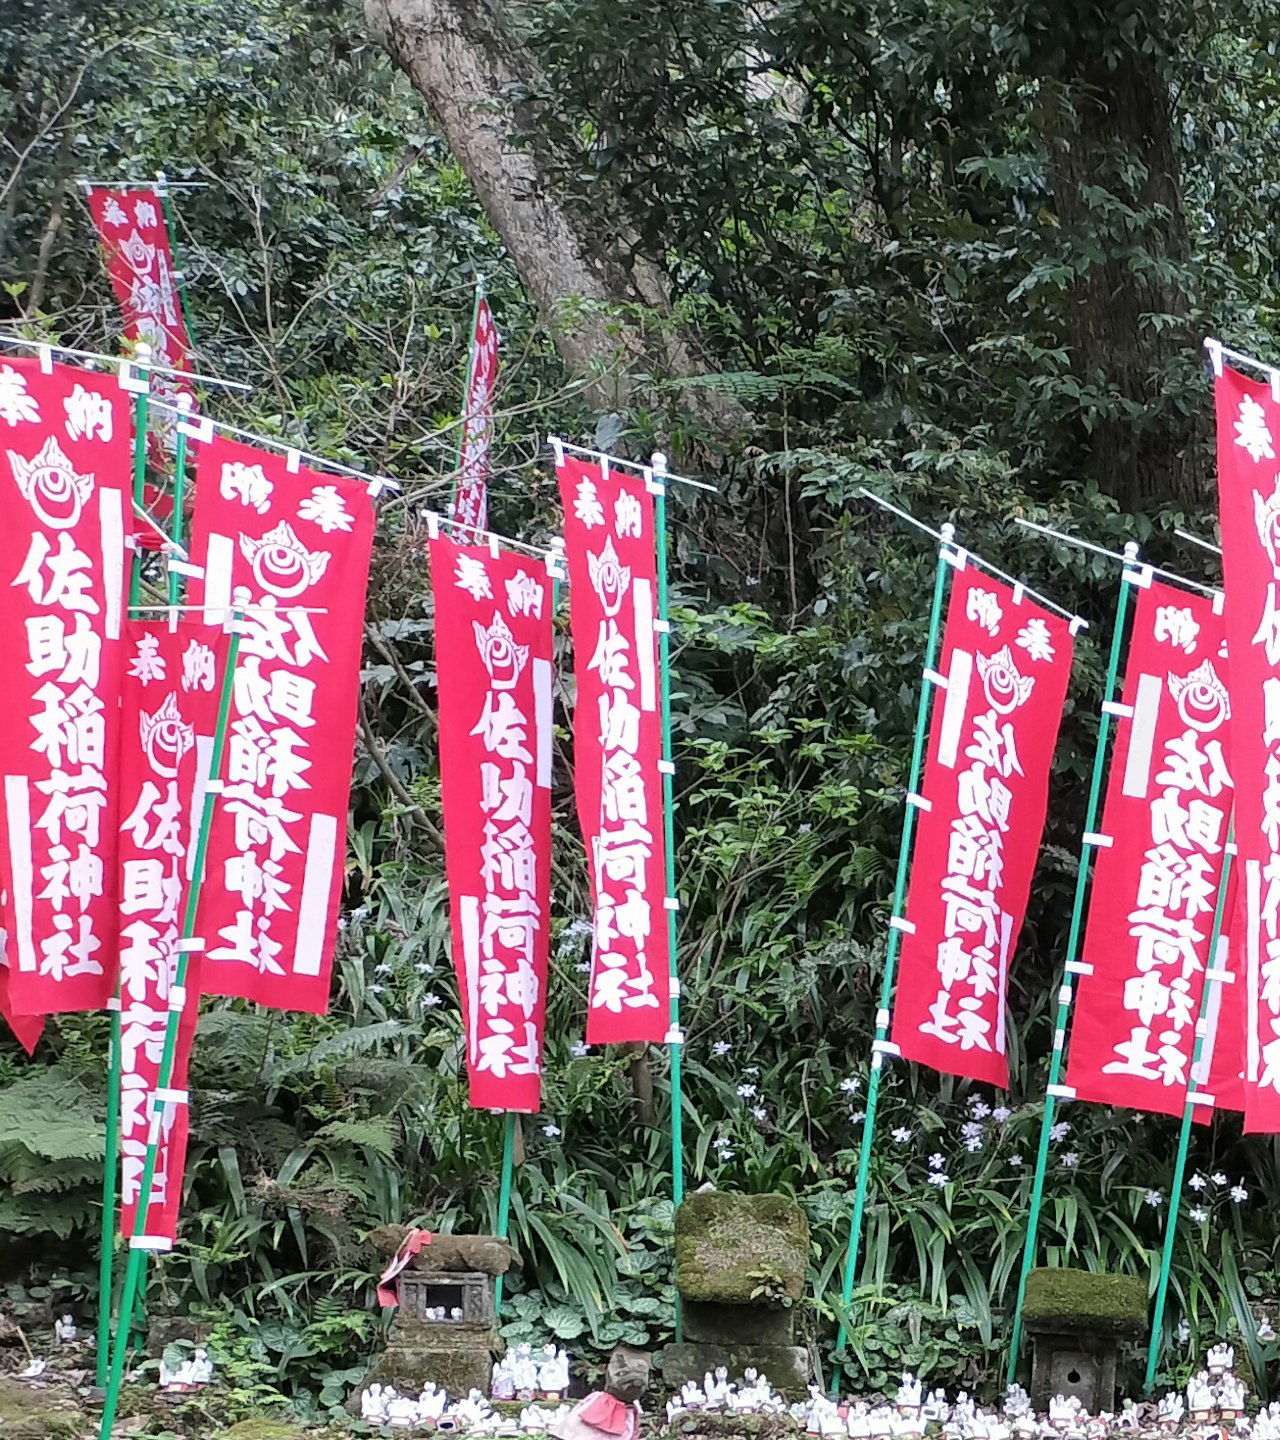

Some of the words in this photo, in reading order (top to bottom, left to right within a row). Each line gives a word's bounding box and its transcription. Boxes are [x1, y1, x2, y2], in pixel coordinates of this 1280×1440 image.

[102, 197, 157, 228] 奉納
[0, 366, 113, 443] 奉納
[573, 475, 641, 539] 奉納
[454, 552, 545, 620] 奉納
[128, 632, 216, 691] 奉納
[11, 531, 107, 981] 佐助稲荷神社
[588, 620, 660, 1013] 佐助稲荷神社
[470, 691, 541, 1077] 佐助稲荷神社
